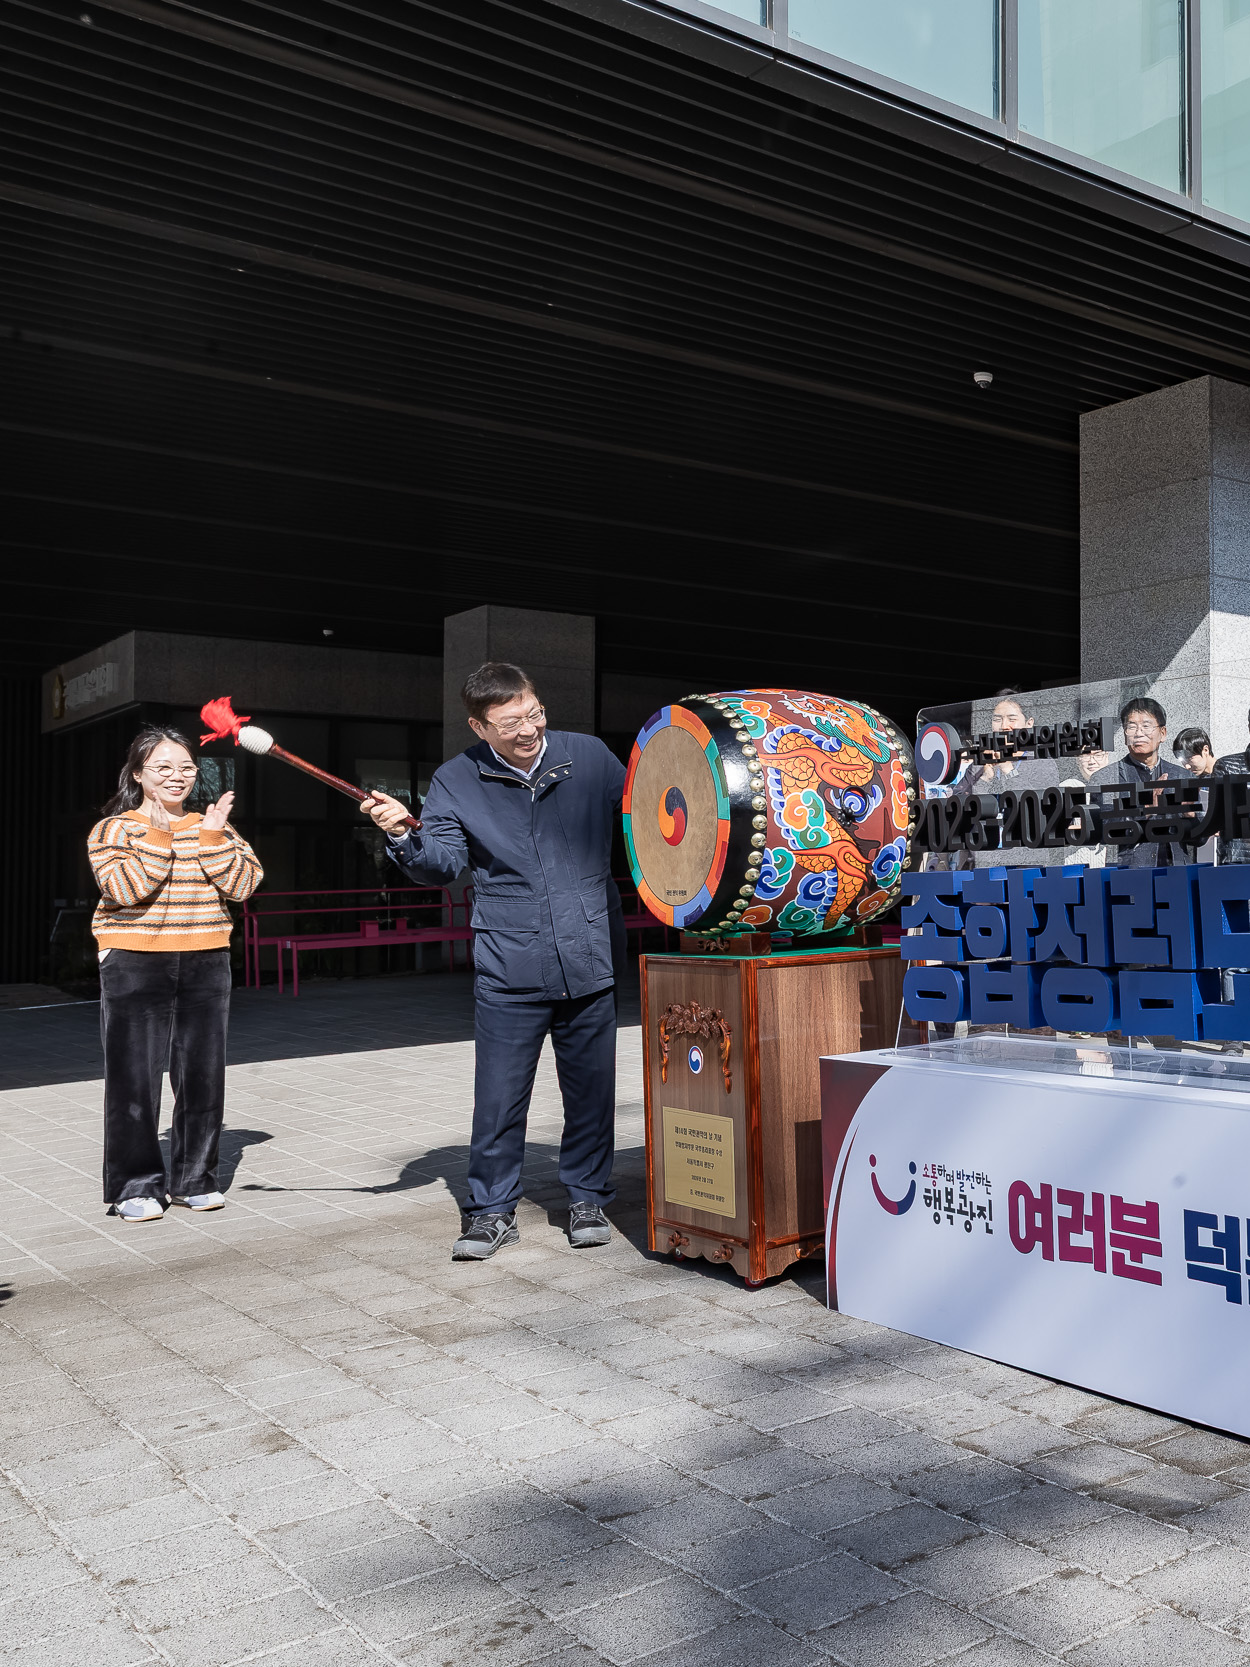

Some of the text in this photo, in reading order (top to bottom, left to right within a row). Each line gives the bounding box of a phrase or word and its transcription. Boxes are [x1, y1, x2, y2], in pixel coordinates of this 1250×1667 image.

[911, 786, 1098, 852] 2023-2025
[923, 1164, 992, 1195] 소통하며 발전하는
[923, 1187, 993, 1234] 행복광진
[1008, 1179, 1163, 1286] 여러분
